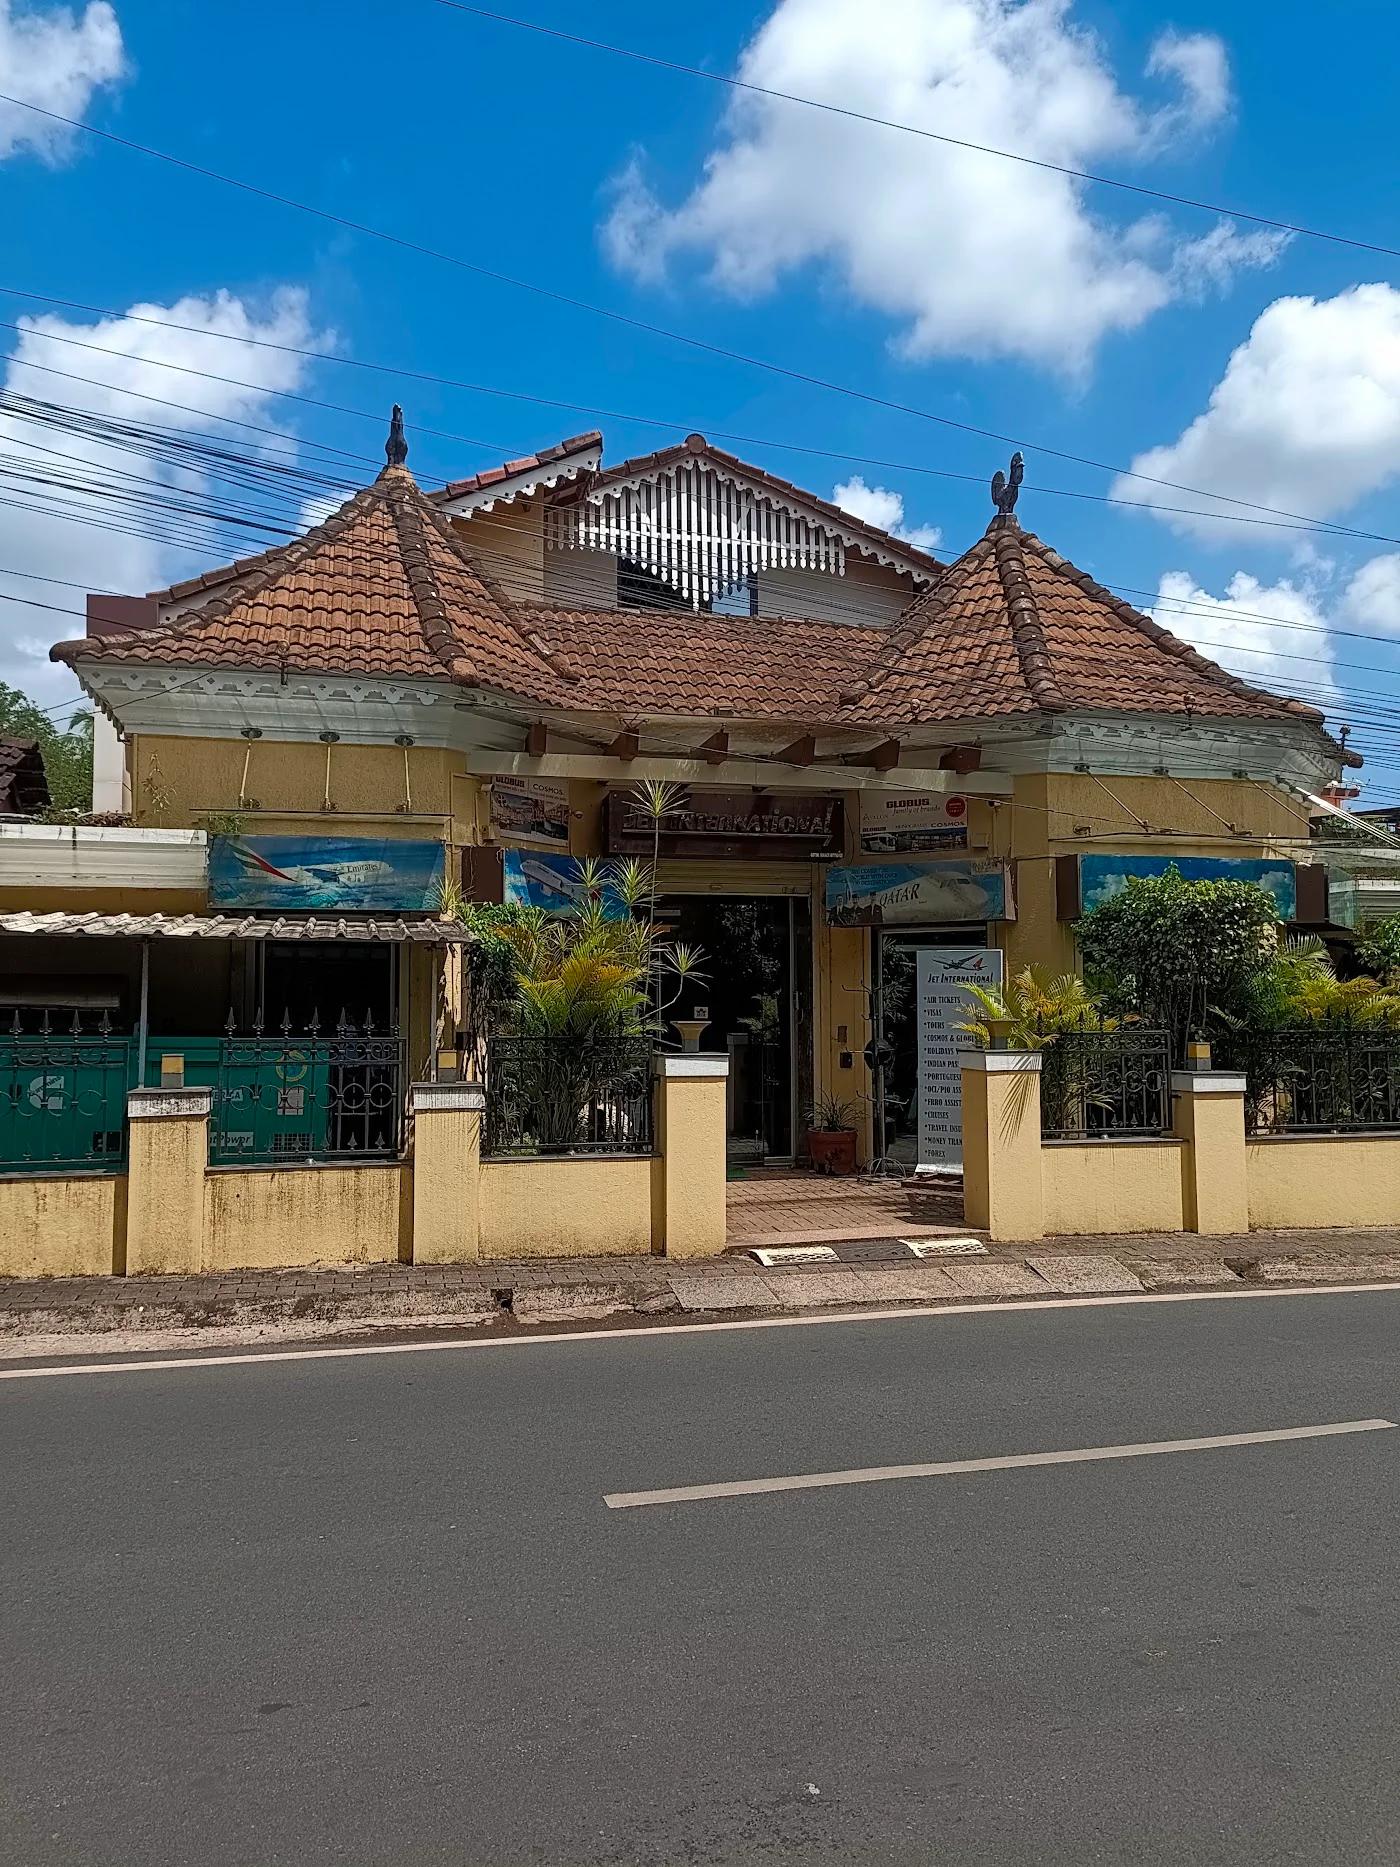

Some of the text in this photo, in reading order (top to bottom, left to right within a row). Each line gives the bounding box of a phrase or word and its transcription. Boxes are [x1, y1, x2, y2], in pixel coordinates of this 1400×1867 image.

[532, 784, 563, 795] COSMOS
[886, 798, 930, 808] GLOBUS
[892, 806, 912, 816] family
[920, 805, 940, 813] brands
[347, 863, 378, 872] Emirates
[879, 884, 920, 908] QATAR
[928, 973, 940, 983] JET
